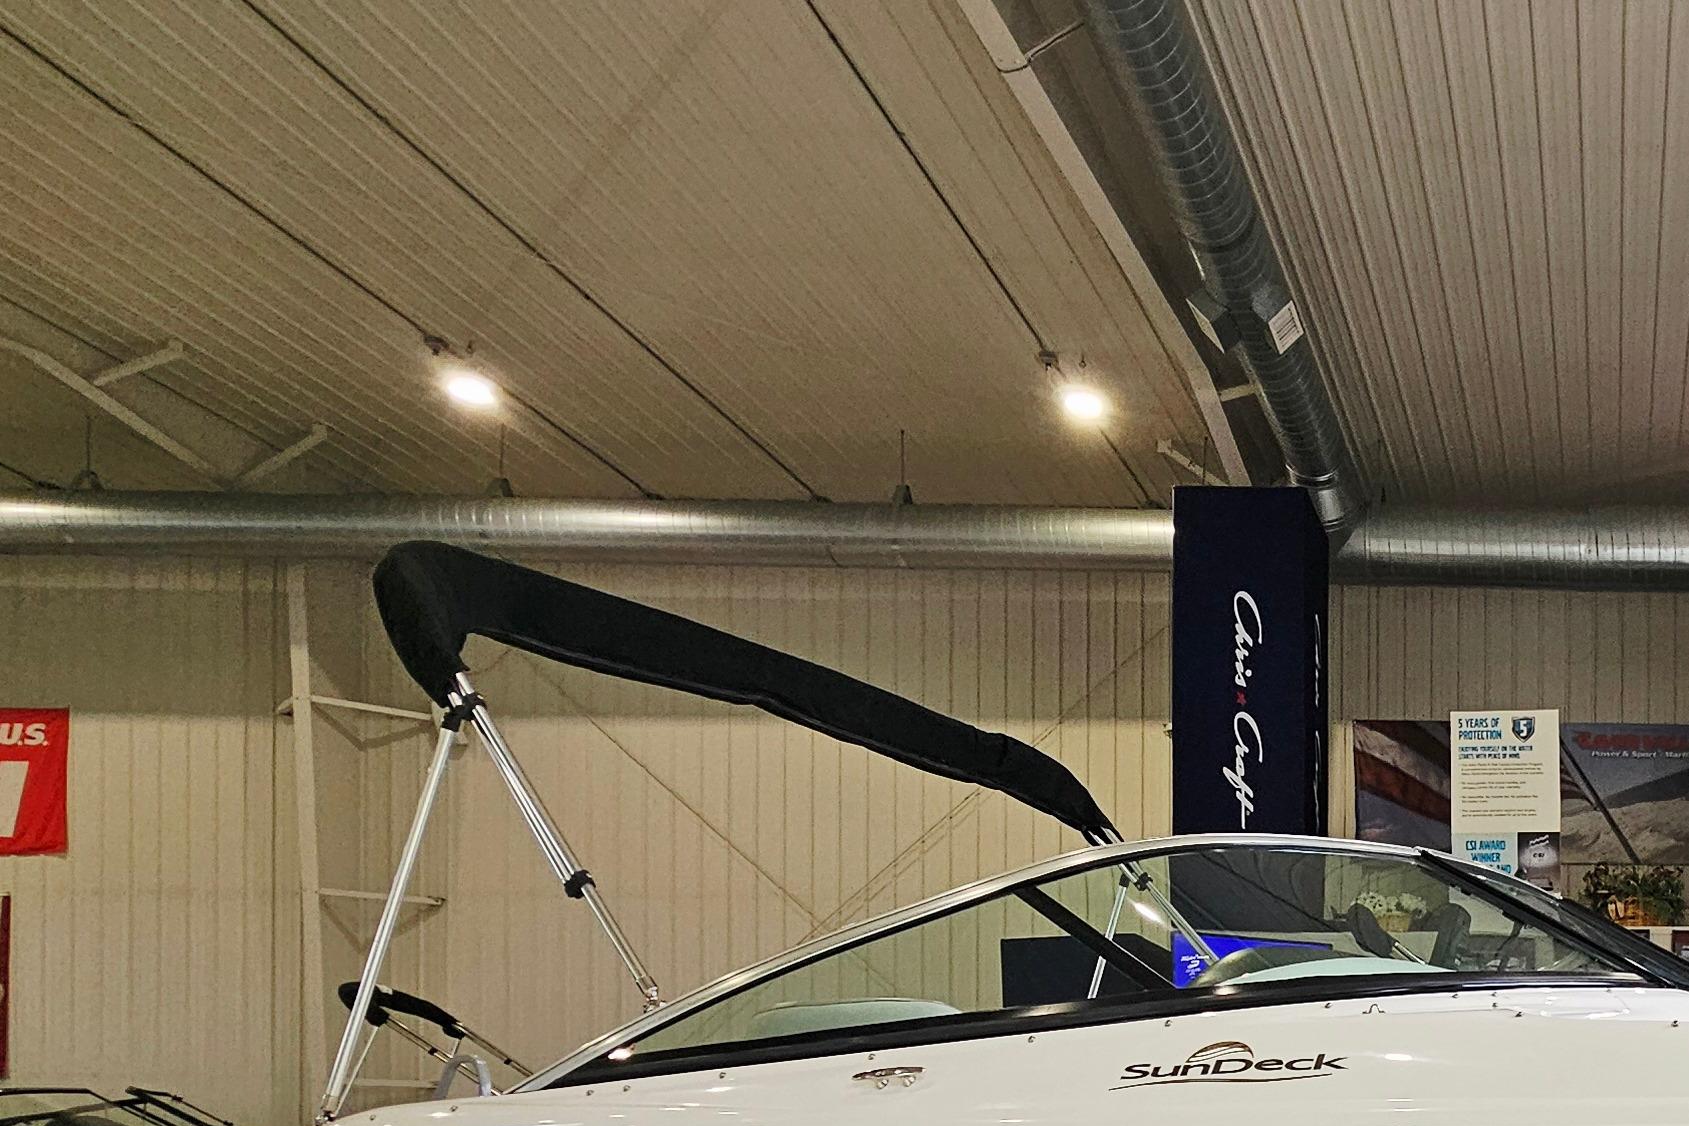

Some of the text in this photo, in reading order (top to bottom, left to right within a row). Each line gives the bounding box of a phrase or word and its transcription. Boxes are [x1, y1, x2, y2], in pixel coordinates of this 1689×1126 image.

[1221, 590, 1263, 830] Chris Craft
[1458, 717, 1500, 728] 5 YEARS OF
[1519, 720, 1528, 737] 5
[1458, 730, 1502, 741] PROTECTION
[1465, 840, 1506, 851] CSI AWARD
[1470, 852, 1501, 863] WINNER
[1119, 1053, 1349, 1080] SunDeck
